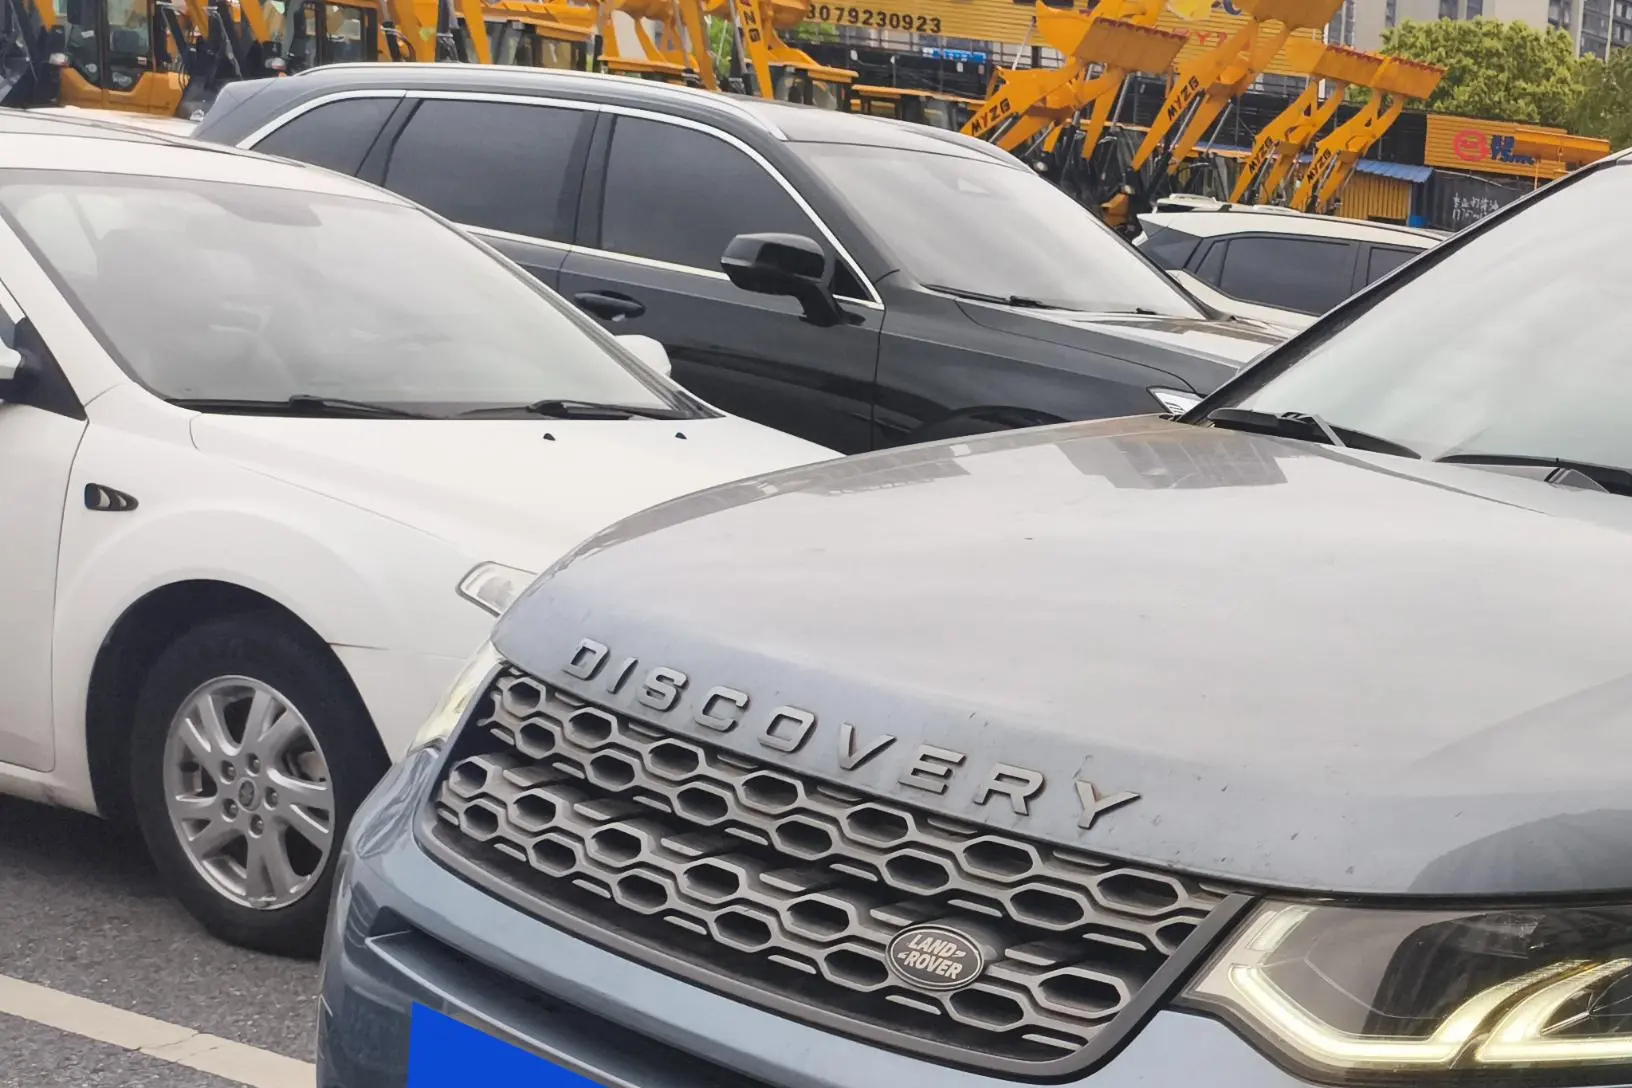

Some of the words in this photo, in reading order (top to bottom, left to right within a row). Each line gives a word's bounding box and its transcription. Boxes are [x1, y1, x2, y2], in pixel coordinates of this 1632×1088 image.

[971, 98, 1011, 132] MYZG
[1167, 75, 1199, 121] MYZG
[1249, 136, 1273, 175] MYZG
[1307, 148, 1331, 184] MYZG
[562, 637, 1142, 830] DISCOVERY
[908, 934, 957, 958] LAND
[904, 951, 963, 979] ROVER
